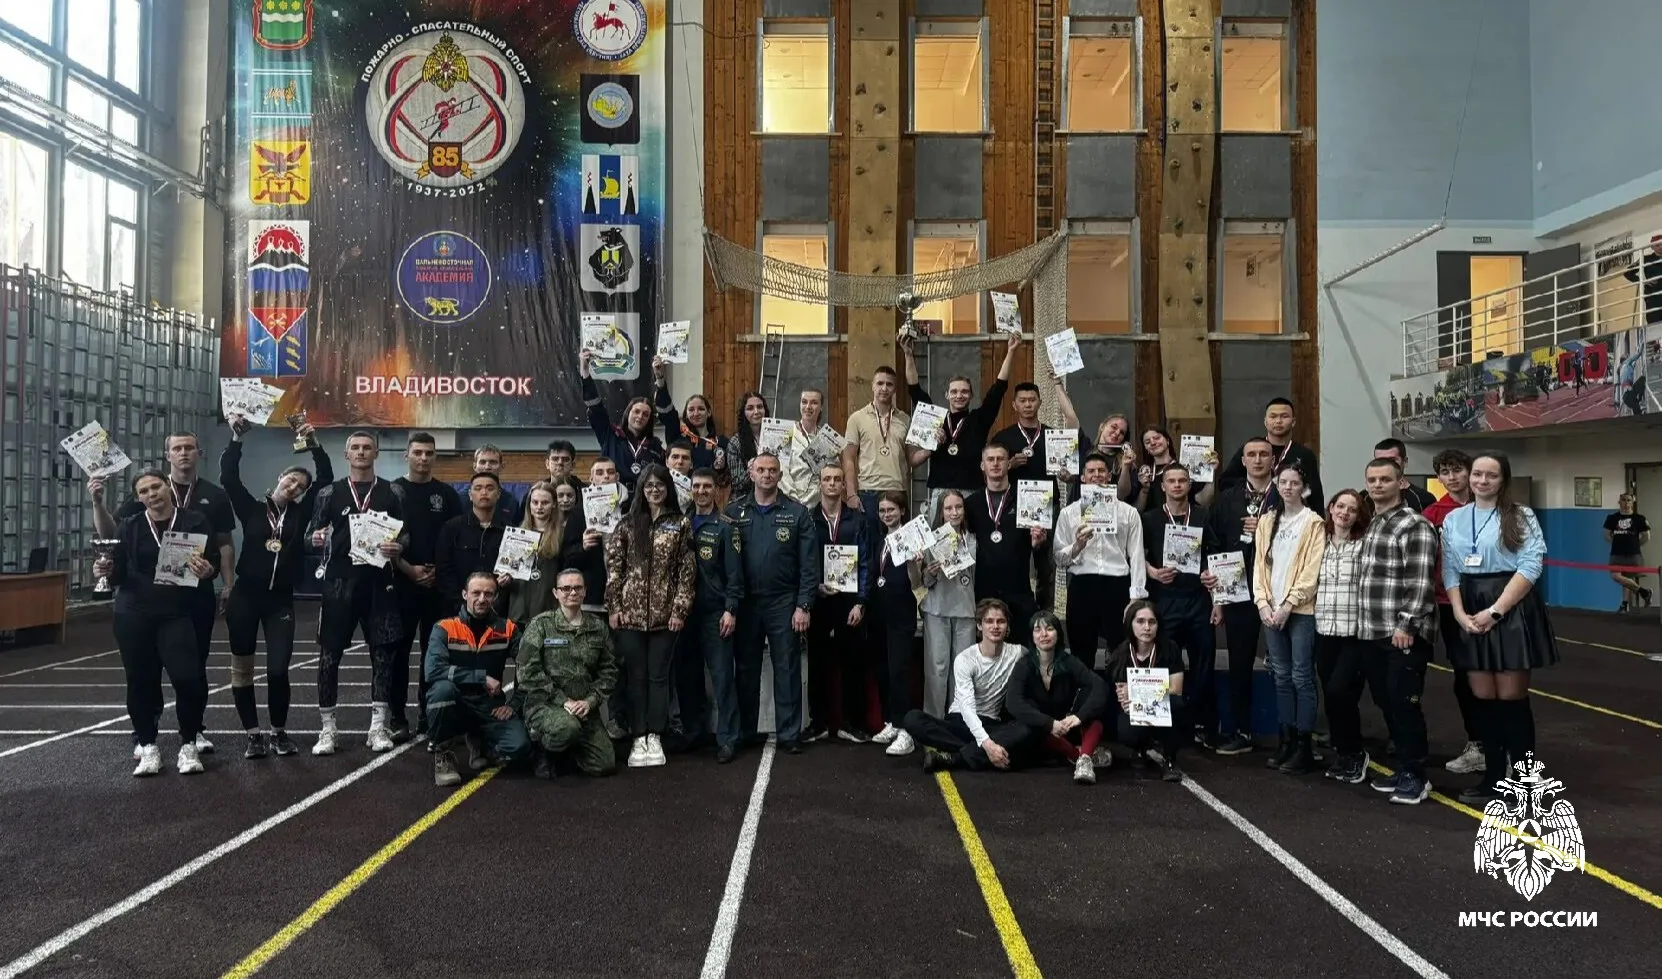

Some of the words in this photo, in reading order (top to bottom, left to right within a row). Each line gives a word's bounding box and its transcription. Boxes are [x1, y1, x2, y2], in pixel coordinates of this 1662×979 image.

[361, 34, 404, 83] ПОЖАРНО
[411, 21, 507, 50] СПАСАТЕЛЬНЫЙ
[505, 48, 532, 85] СПОРТ
[432, 146, 459, 167] 85
[407, 182, 486, 198] 1937-2022
[416, 272, 474, 283] АКАДЕМИЯ
[356, 376, 531, 397] ВЛАДИВОСТОК
